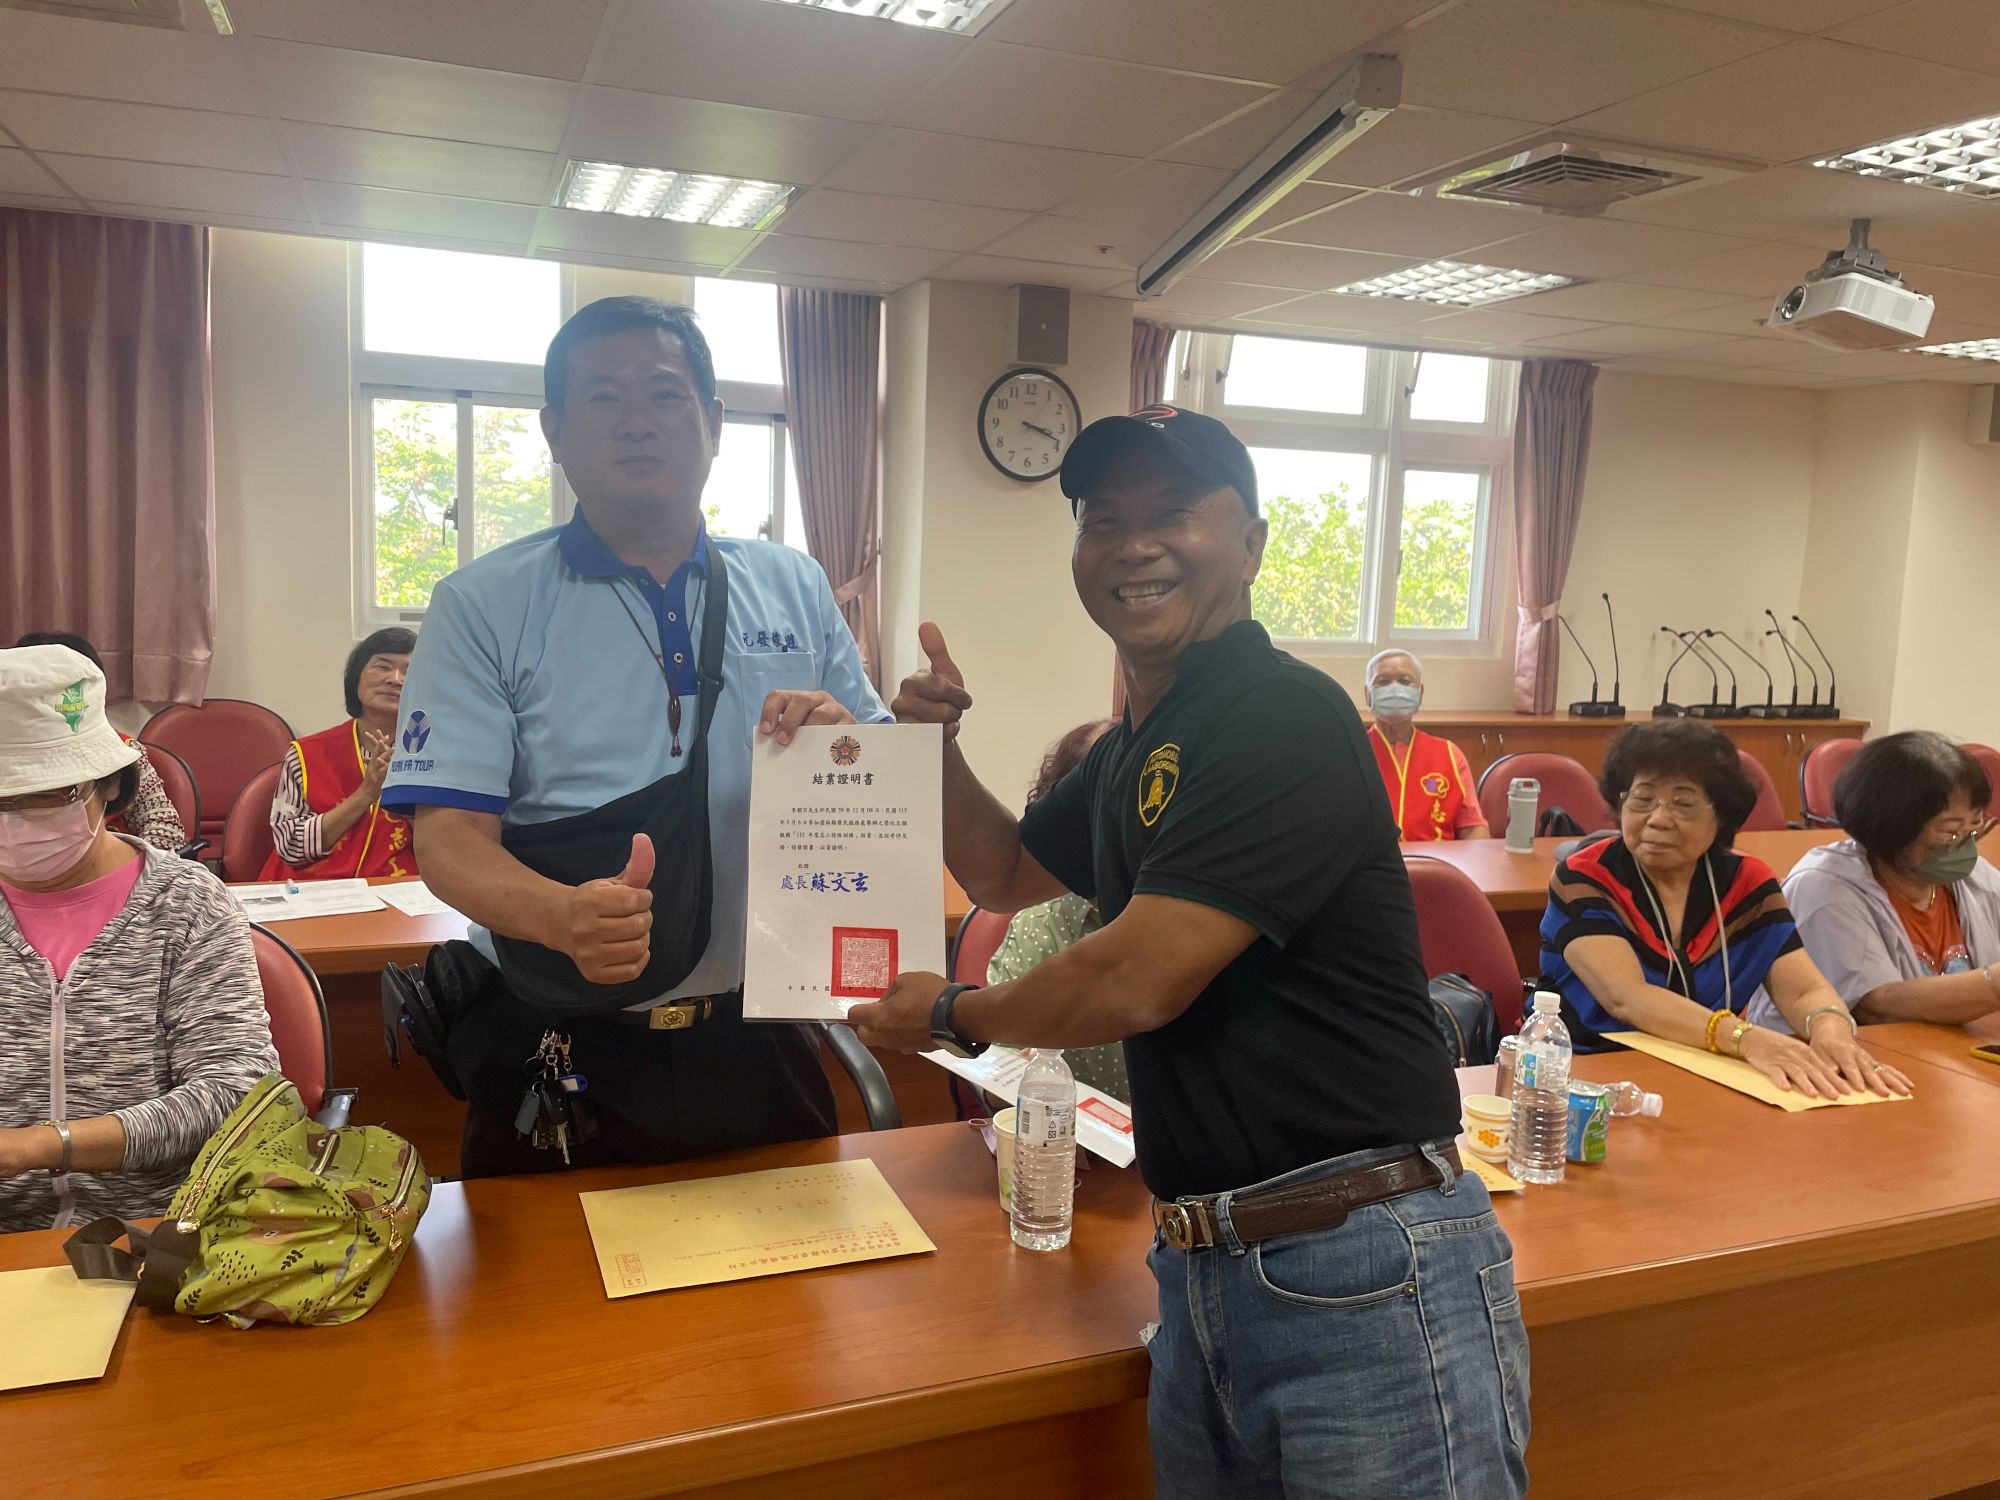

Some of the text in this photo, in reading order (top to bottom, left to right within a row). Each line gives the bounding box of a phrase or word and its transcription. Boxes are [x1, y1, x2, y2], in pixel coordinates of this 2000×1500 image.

[1009, 386, 1019, 399] 11
[1026, 383, 1037, 395] 12
[1046, 390, 1052, 402] 1
[997, 398, 1009, 410] 10
[1056, 404, 1063, 415] 2
[992, 417, 1000, 428] 9
[1058, 423, 1066, 434] 3
[996, 436, 1004, 448] 8
[1008, 450, 1016, 462] 7
[1041, 453, 1049, 465] 5
[1023, 457, 1032, 468] 6
[414, 759, 434, 772] TOUR
[812, 772, 875, 786] 結業證明書
